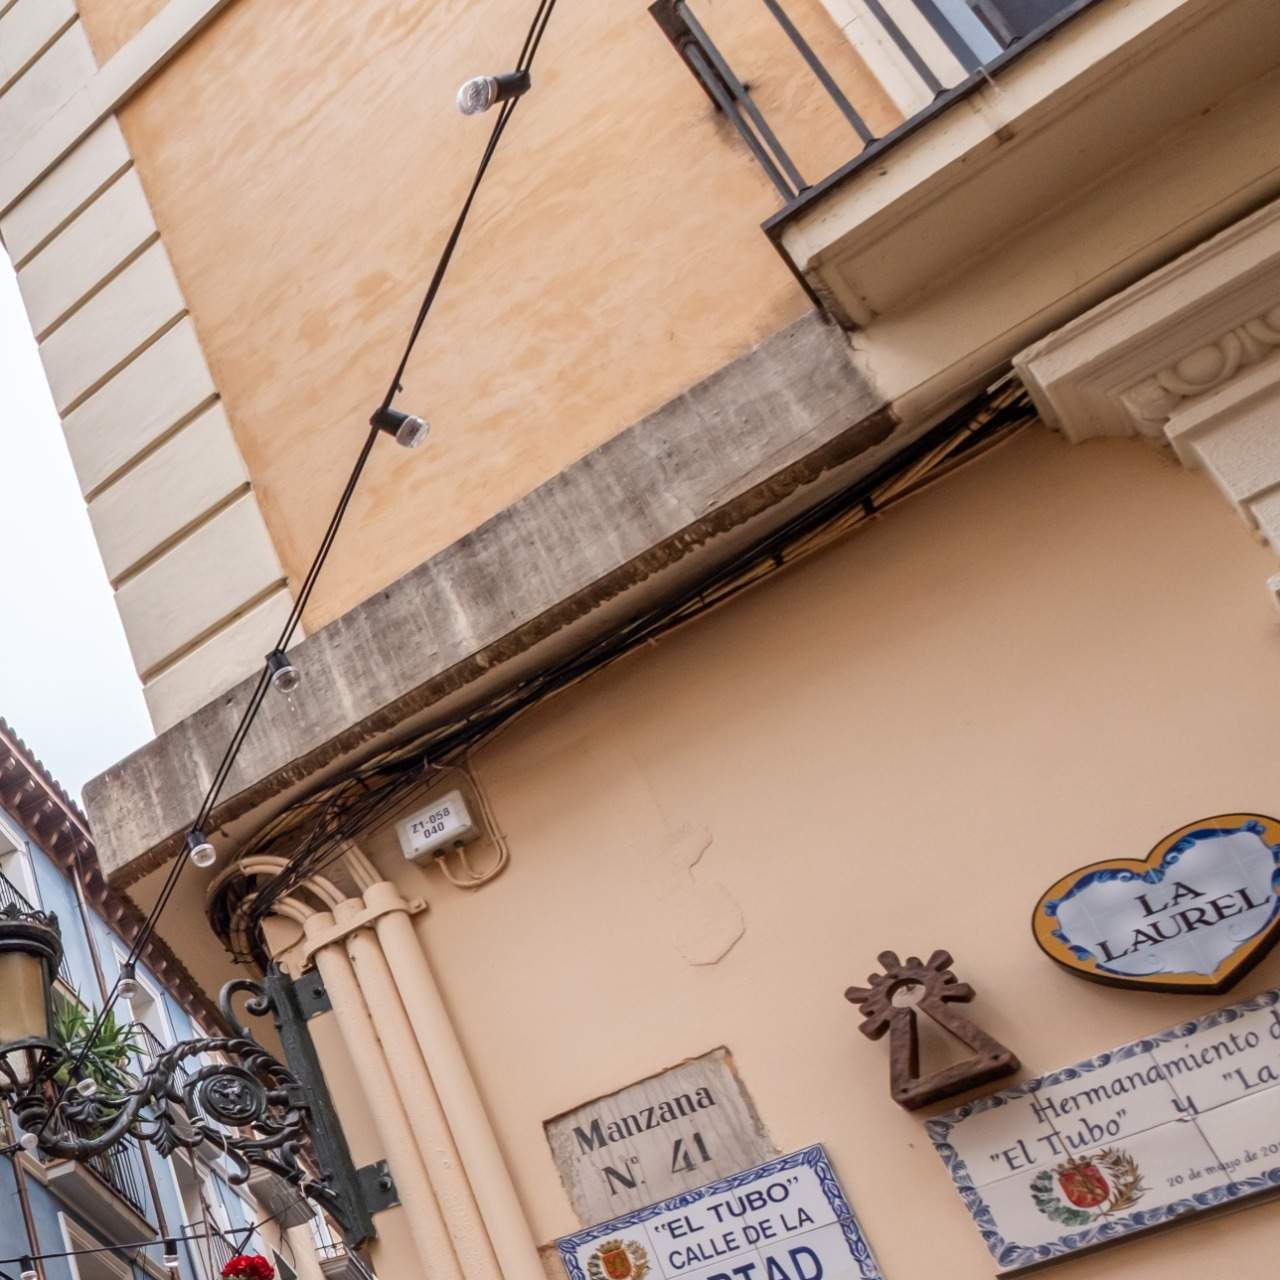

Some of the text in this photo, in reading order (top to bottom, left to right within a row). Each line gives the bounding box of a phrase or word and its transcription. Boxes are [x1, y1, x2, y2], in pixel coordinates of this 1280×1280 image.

[410, 807, 451, 835] Z1-058
[423, 821, 445, 840] 040
[1133, 881, 1207, 918] LA
[1095, 886, 1273, 964] LAUREL
[1030, 1028, 1260, 1125] Hermanamiento
[572, 1086, 717, 1156] Manzana
[671, 1131, 713, 1174] 41
[1188, 1168, 1202, 1181] de
[1243, 1149, 1259, 1164] de
[668, 1206, 815, 1270] CALLE DE LA
